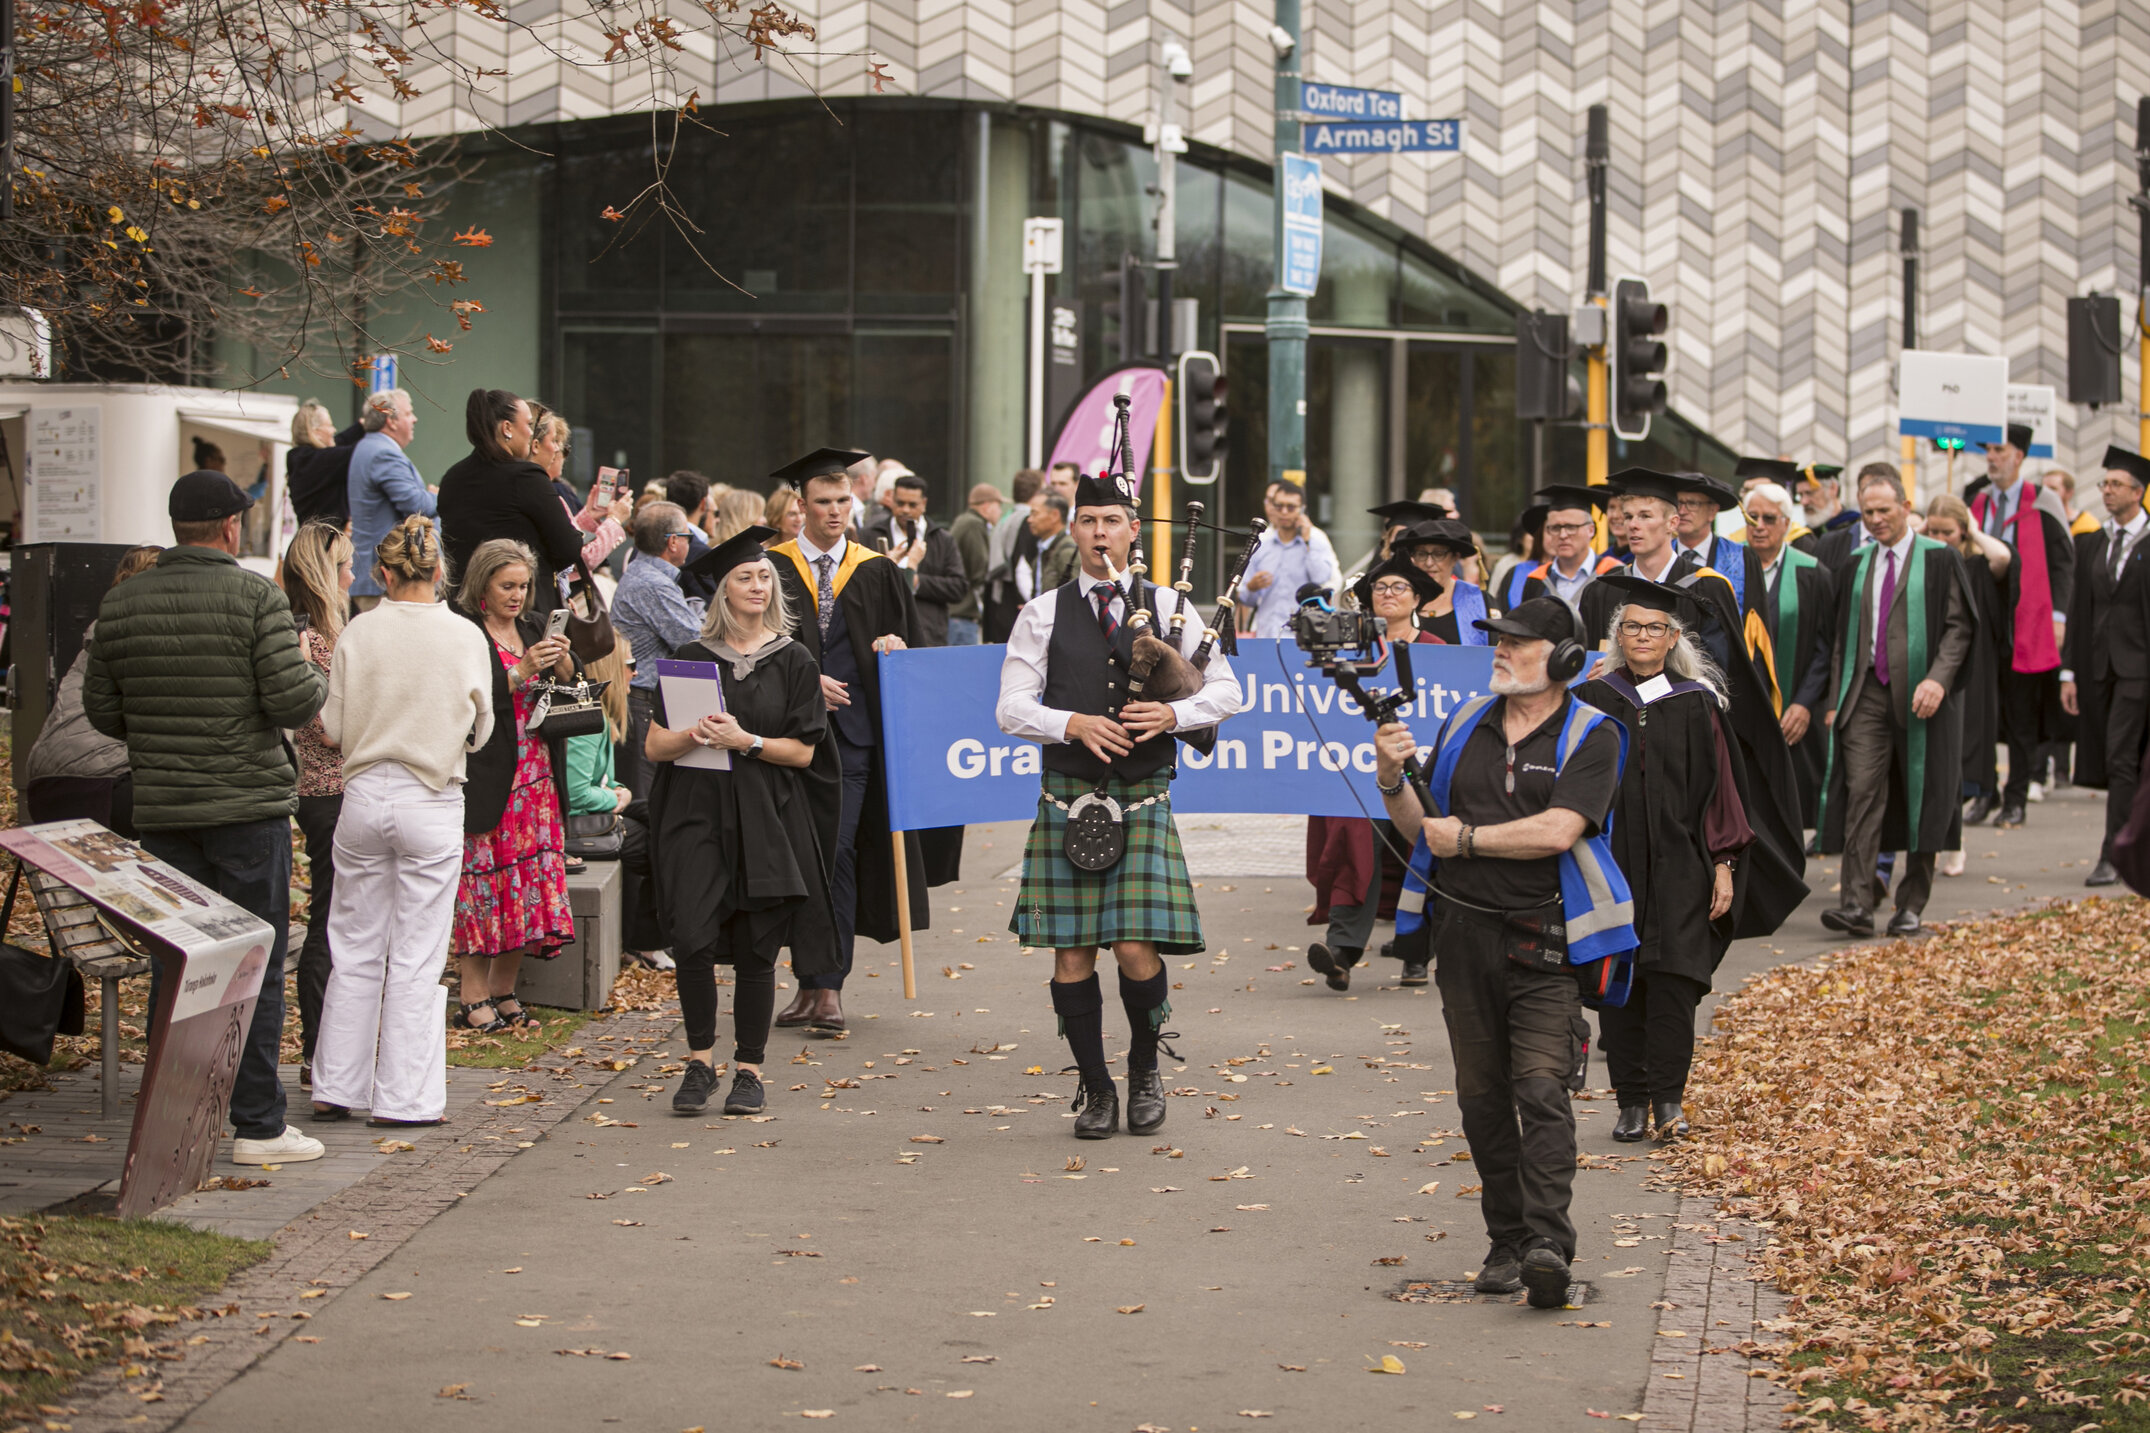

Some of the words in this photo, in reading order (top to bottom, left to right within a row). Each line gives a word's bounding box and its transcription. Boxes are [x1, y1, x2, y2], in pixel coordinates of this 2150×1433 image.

[1305, 85, 1364, 114] Oxford
[1367, 93, 1398, 117] Tce
[1314, 125, 1418, 152] Armagh
[1425, 122, 1454, 146] St
[1942, 384, 1960, 395] PhD
[1239, 672, 1478, 719] Univesit
